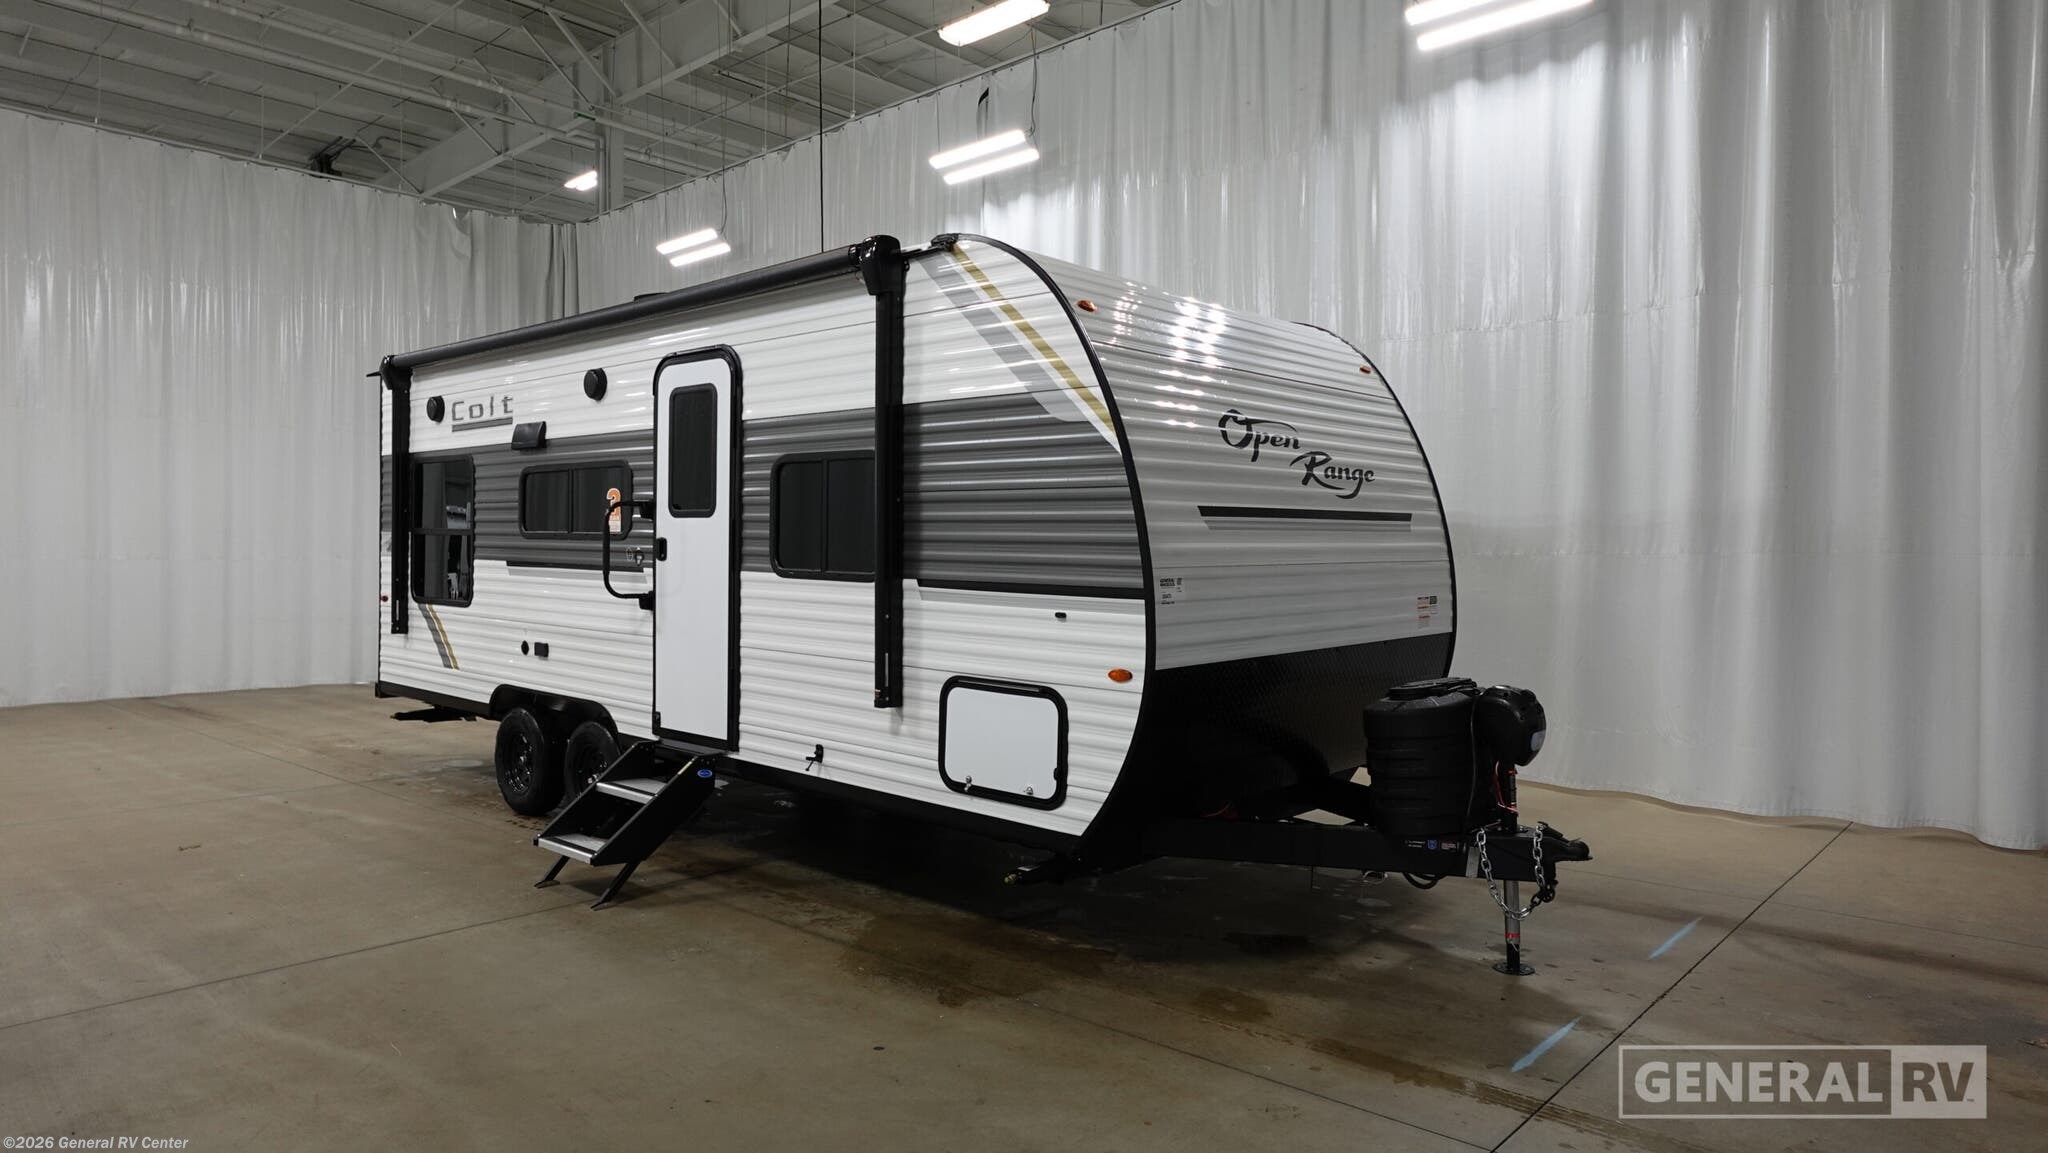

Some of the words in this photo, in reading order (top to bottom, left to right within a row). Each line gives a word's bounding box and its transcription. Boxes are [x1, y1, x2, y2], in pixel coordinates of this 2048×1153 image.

[452, 396, 513, 421] Colt
[1218, 409, 1300, 462] Open
[1290, 451, 1375, 499] Range
